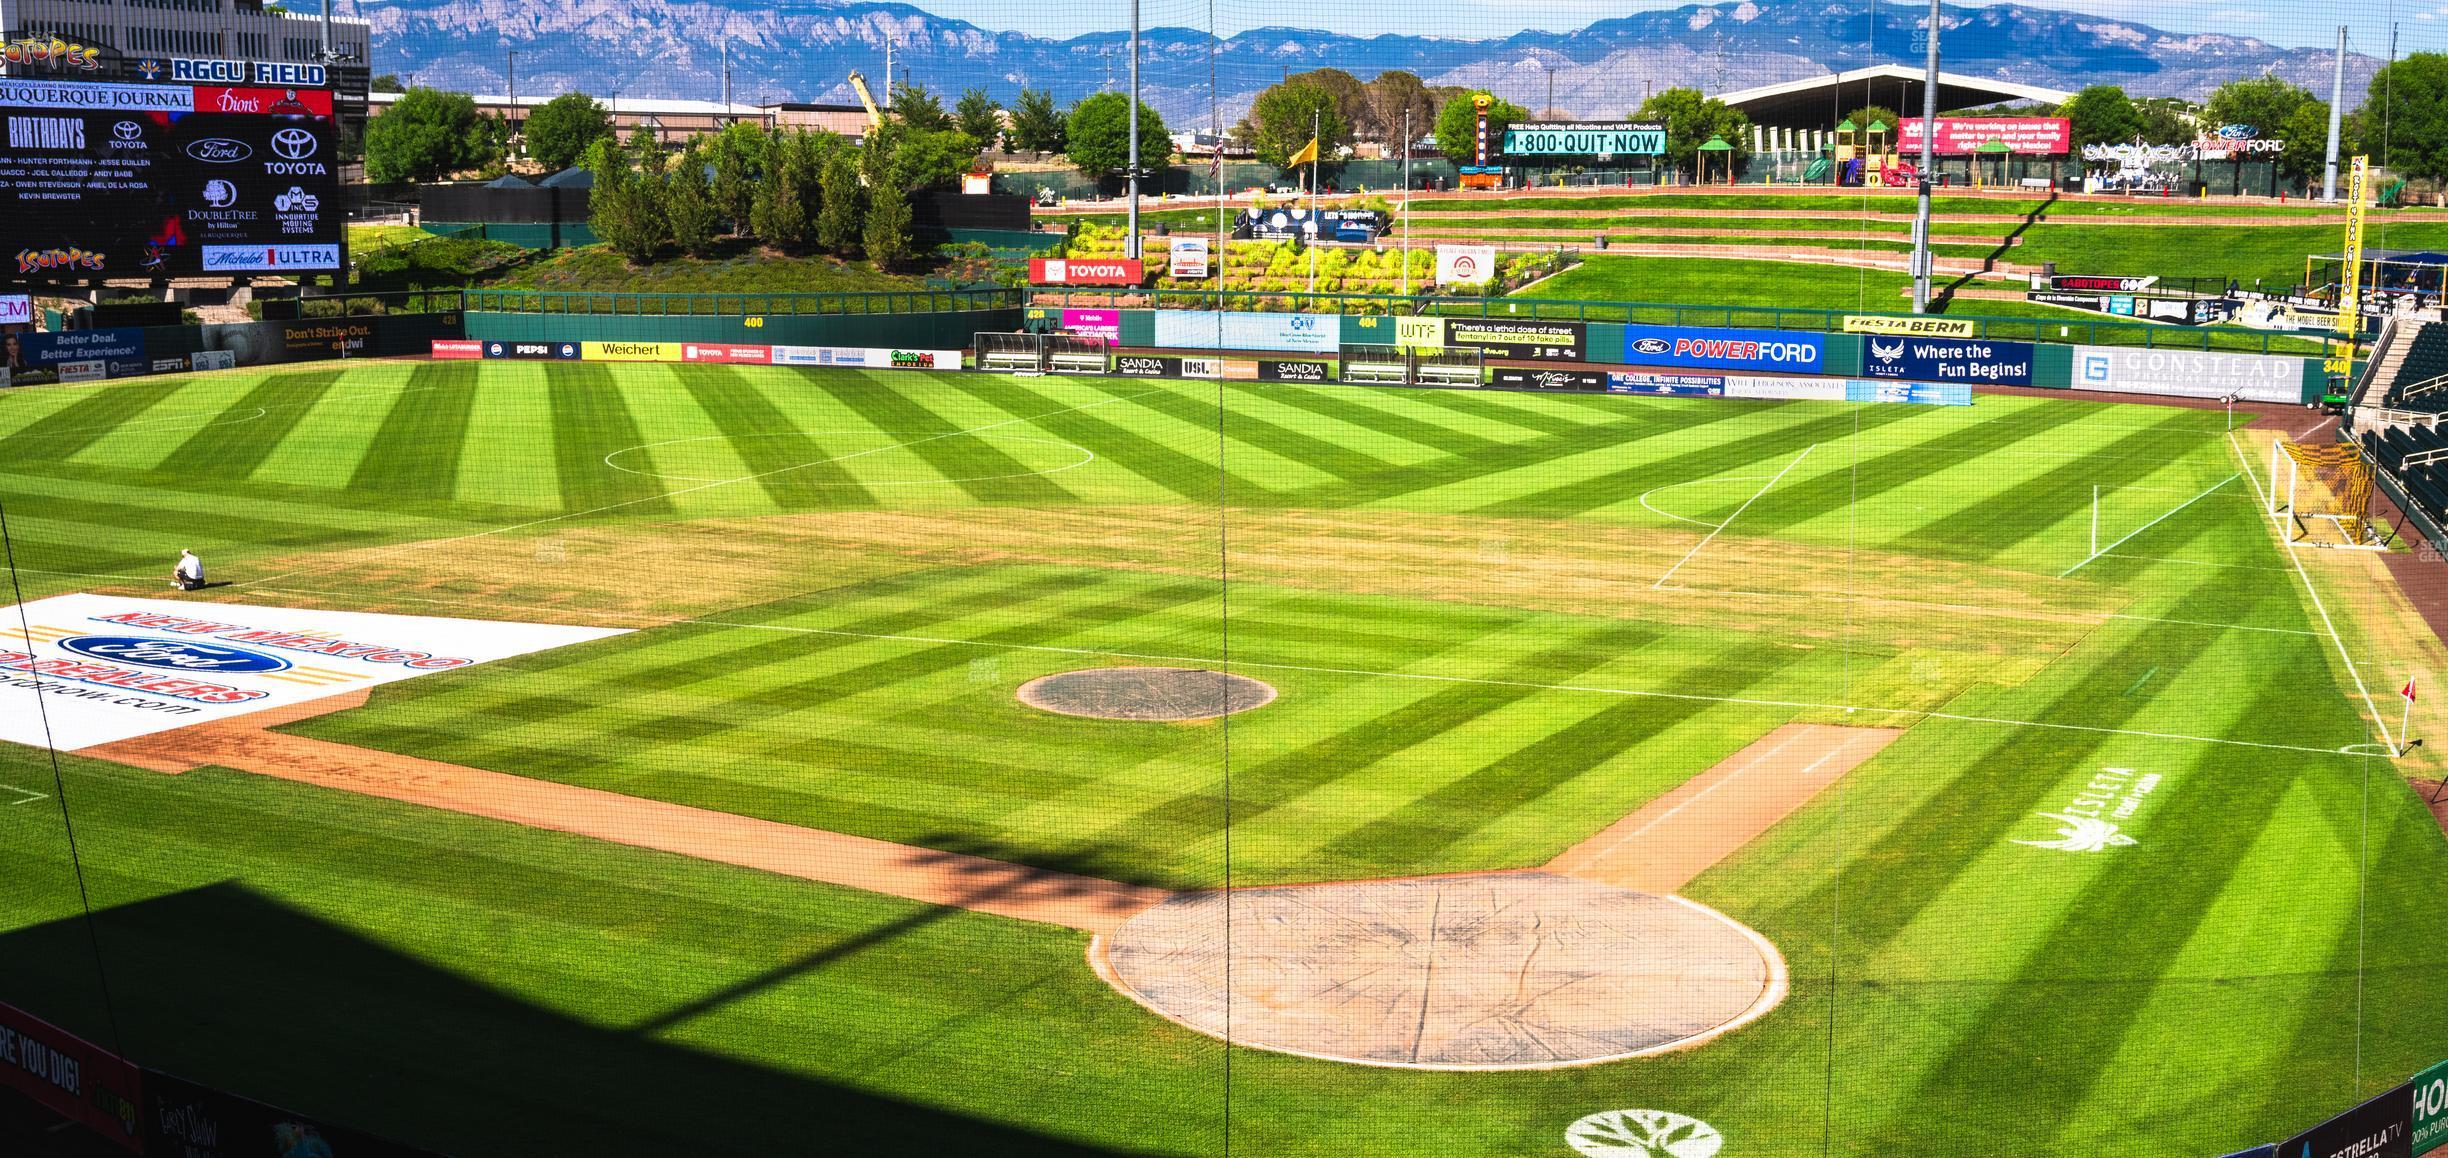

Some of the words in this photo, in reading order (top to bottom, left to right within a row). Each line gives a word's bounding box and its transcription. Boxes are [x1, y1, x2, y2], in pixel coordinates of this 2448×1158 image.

[171, 58, 245, 82] RGCU
[253, 61, 326, 85] FIELD
[112, 90, 191, 107] JOURNAL
[217, 88, 259, 112] Dion's
[8, 116, 85, 149] BIRTHDAYS
[1540, 123, 1565, 131] Quitting
[1974, 122, 2006, 131] working
[2018, 122, 2042, 130] issues
[2043, 122, 2060, 130] that
[2226, 127, 2250, 138] Ford
[2035, 133, 2061, 141] family
[109, 141, 147, 149] TOYOTA
[200, 141, 239, 158] Ford
[1957, 142, 1976, 150] right
[2191, 139, 2286, 151] POWERFORD
[17, 157, 47, 165] HUNTER
[264, 162, 326, 175] TOYOTA
[207, 251, 264, 266] Michelob
[279, 250, 335, 263] ULTRA
[1069, 265, 1126, 277] TOYOTA
[1028, 310, 1045, 319] 428
[744, 317, 763, 328] 400
[1850, 318, 1907, 328] FIESTA
[1910, 321, 1966, 333] BERM
[2297, 316, 2316, 326] MODEL
[2317, 317, 2331, 326] BEER
[285, 328, 316, 340] Don't
[316, 327, 348, 338] Strike
[349, 325, 371, 335] Out.
[1401, 324, 1436, 338] WTF
[1493, 325, 1516, 333] lethal
[56, 334, 89, 345] Better
[91, 333, 117, 344] Deal.
[1457, 333, 1489, 341] fentanyl
[1555, 336, 1573, 345] pills.
[517, 345, 548, 354] PEPSI
[602, 343, 660, 356] Weichert
[1638, 340, 1664, 352] Ford
[1674, 338, 1817, 363] POWERFORD
[1914, 344, 1962, 358] Where
[1966, 345, 1992, 358] the
[41, 349, 72, 360] Better
[890, 350, 919, 361] Clark's
[919, 353, 935, 361] Pet
[60, 364, 90, 374] FIESTA
[1120, 358, 1163, 369] SANDIA
[1278, 363, 1323, 374] SANDIA
[1869, 365, 1905, 373] ISLETA
[2126, 352, 2290, 379] GONSTEAD
[2323, 360, 2346, 373] 340
[1938, 363, 1966, 377] Fun
[1970, 362, 2027, 380] Begins!
[1653, 376, 1679, 384] INFINITE
[1680, 377, 1721, 385] POSSIBILITIES
[2211, 375, 2279, 388] MEDICINE
[88, 611, 247, 634] NEW
[215, 627, 474, 669] MEXICO
[89, 641, 250, 669] Ford
[13, 657, 270, 704] DEALERS
[18, 1033, 48, 1078] YOU
[50, 1048, 80, 1096] DIG!
[2388, 1120, 2403, 1141] TV
